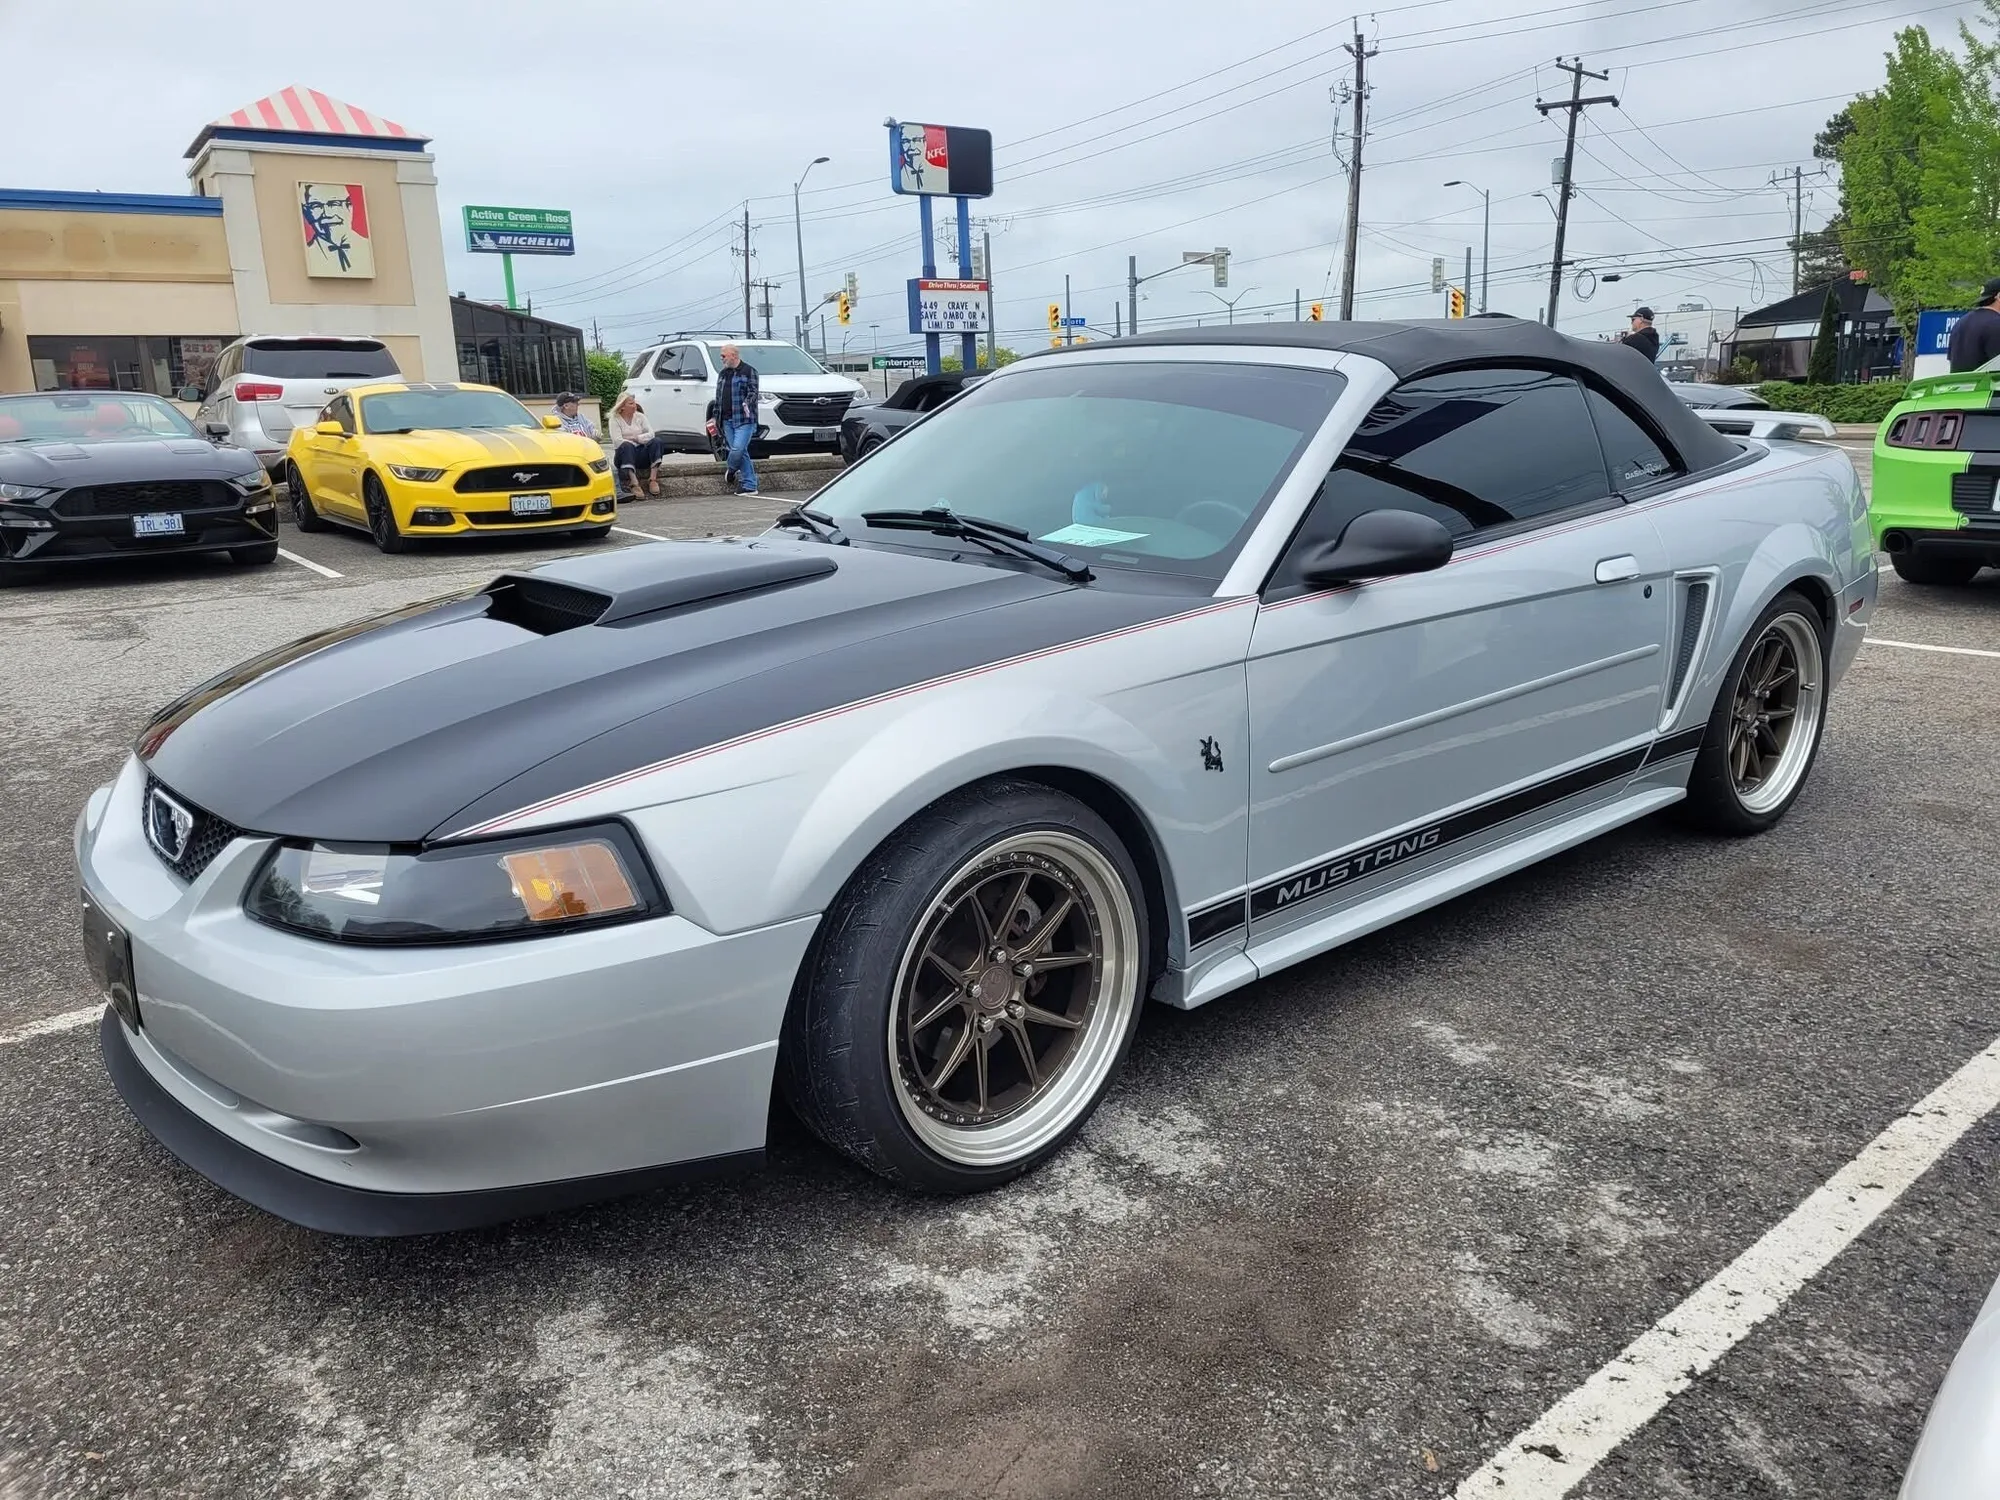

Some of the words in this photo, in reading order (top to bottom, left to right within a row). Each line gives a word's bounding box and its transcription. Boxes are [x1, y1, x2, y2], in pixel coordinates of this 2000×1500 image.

[927, 146, 945, 160] KFC
[471, 210, 504, 220] Active
[508, 211, 537, 221] Green
[545, 213, 569, 223] Ross
[498, 235, 571, 247] MICHELIN
[928, 281, 943, 289] Drive
[960, 282, 980, 291] Seating
[947, 301, 968, 310] CRAVE
[975, 302, 980, 310] N
[920, 311, 937, 320] SAVE
[943, 311, 964, 320] OMBO
[968, 312, 977, 320] OR
[981, 312, 986, 320] A
[962, 321, 979, 330] TIME
[1062, 318, 1083, 326] Sott
[875, 358, 925, 368] enterprise
[134, 519, 159, 532] CTRL
[164, 518, 182, 530] 981
[1276, 828, 1441, 905] MUSTANG
